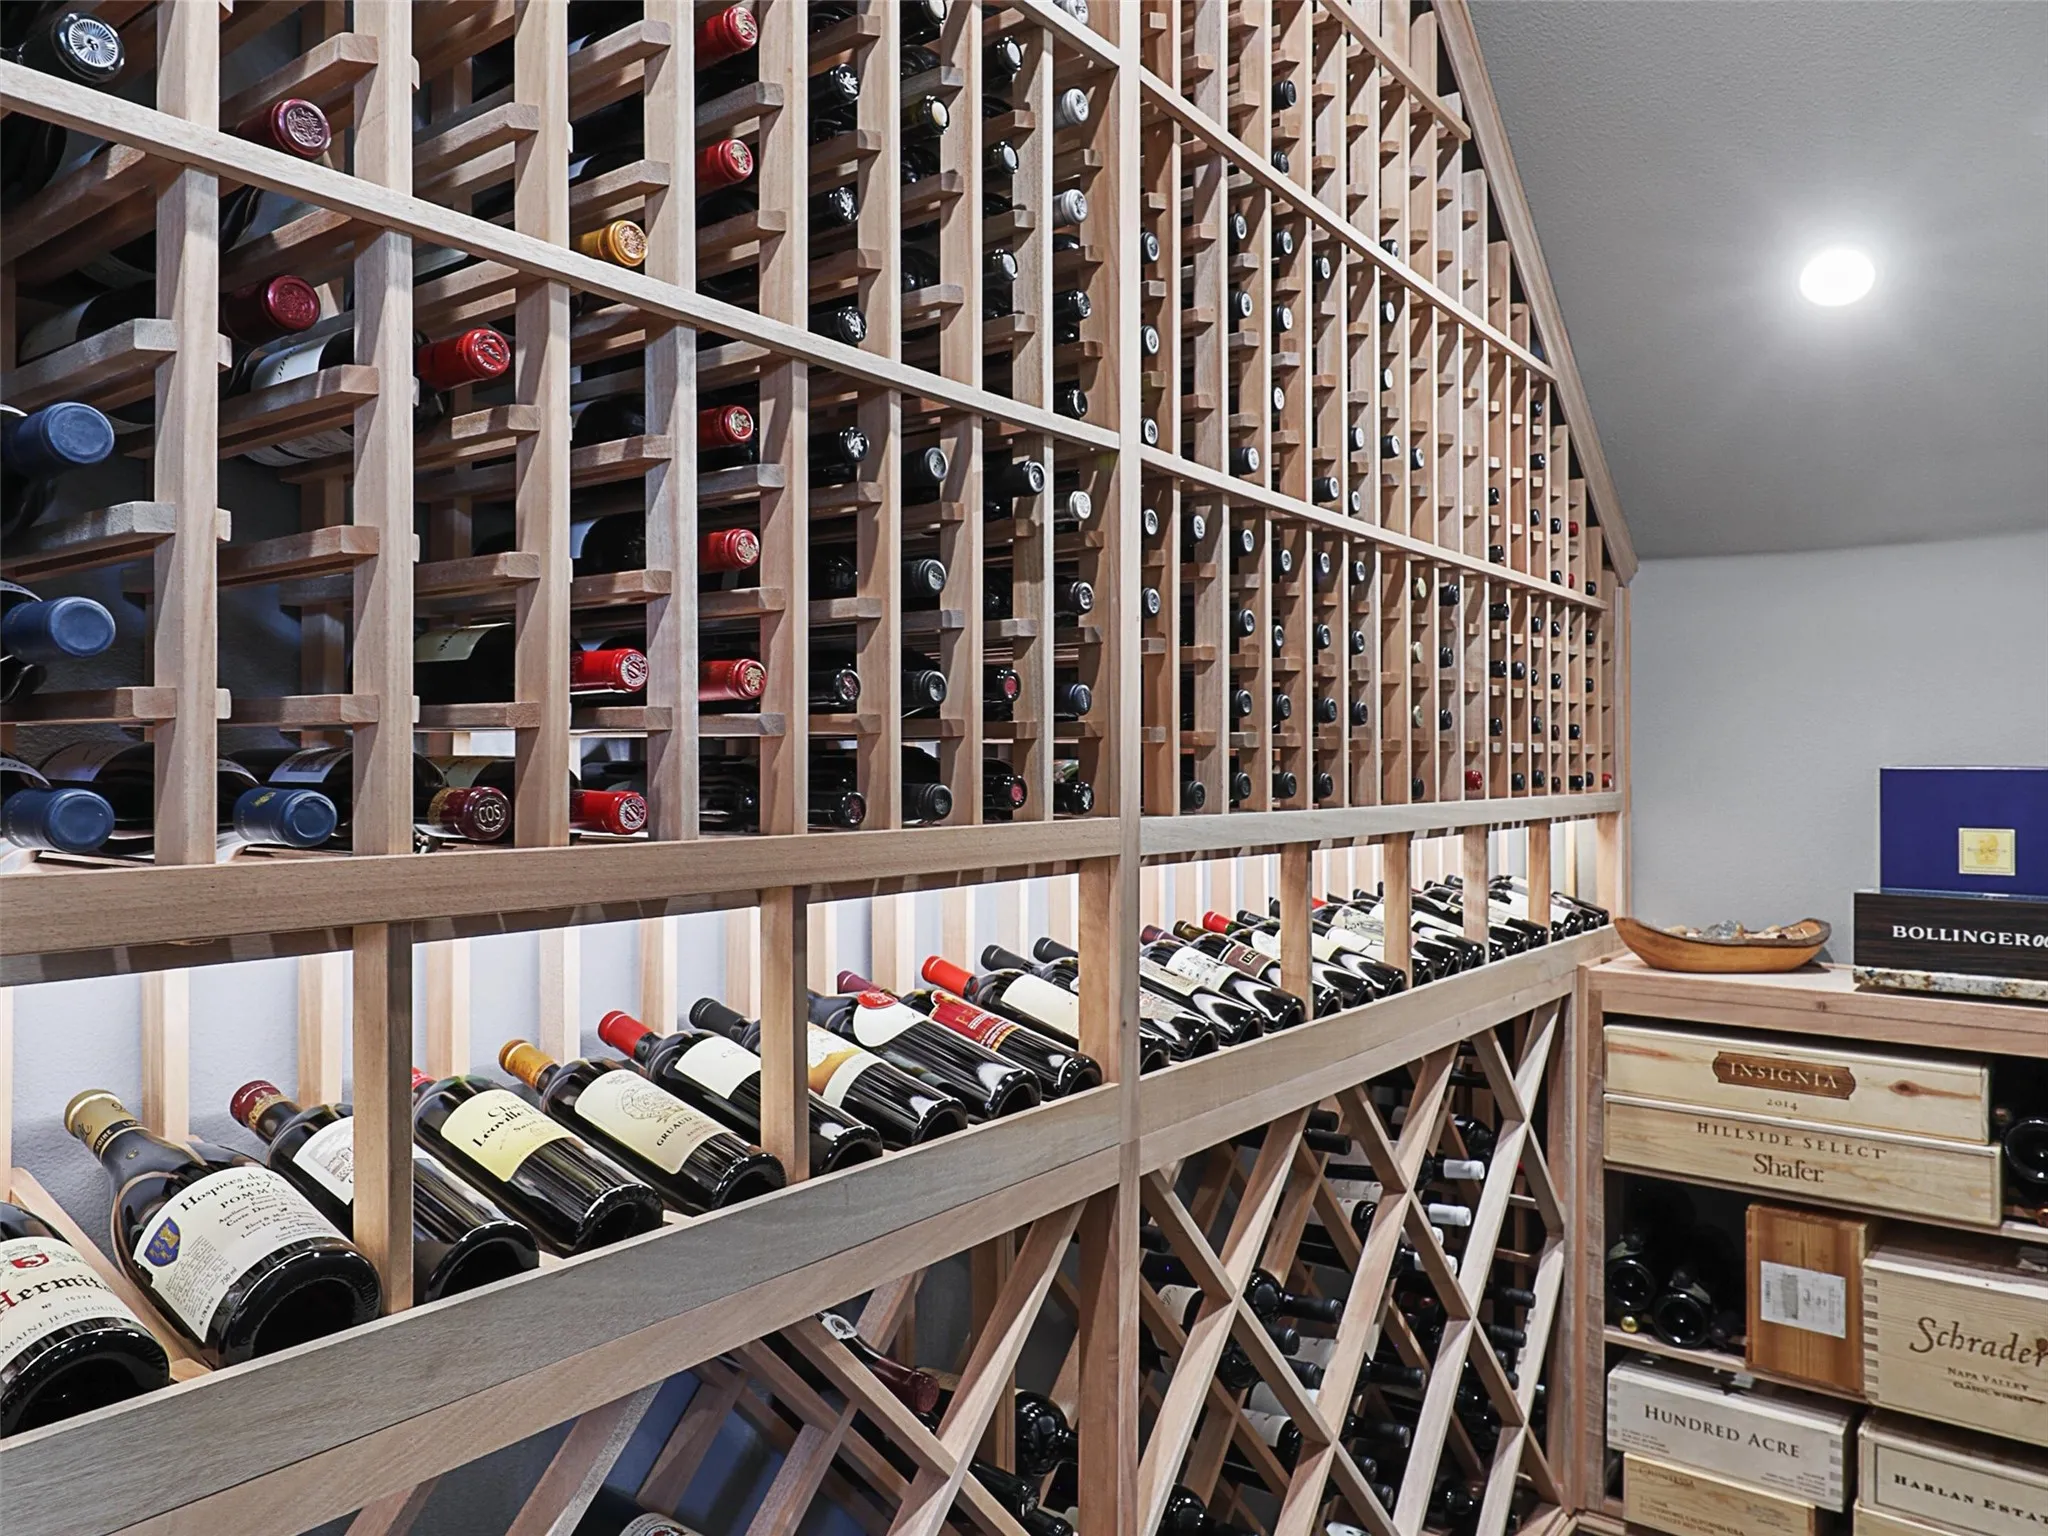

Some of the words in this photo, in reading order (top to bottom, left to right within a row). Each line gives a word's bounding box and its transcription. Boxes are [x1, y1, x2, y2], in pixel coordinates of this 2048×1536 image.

[479, 804, 501, 823] COS
[1730, 1062, 1838, 1089] INSIGNIA
[1766, 1098, 1798, 1111] 2014
[656, 1116, 693, 1147] GRUAUD
[1697, 1121, 1793, 1147] HILLSIDE
[1803, 1137, 1885, 1160] SELECT
[179, 1176, 244, 1212] Hospices
[237, 1180, 272, 1191] 2017
[1909, 1316, 2048, 1367] Schrader
[1947, 1367, 1979, 1381] NAPA
[1982, 1374, 2029, 1391] VALLEY
[1644, 1404, 1740, 1442] HUNDRED
[1748, 1433, 1800, 1459] ACRE
[1894, 1474, 1975, 1504] HARLAN
